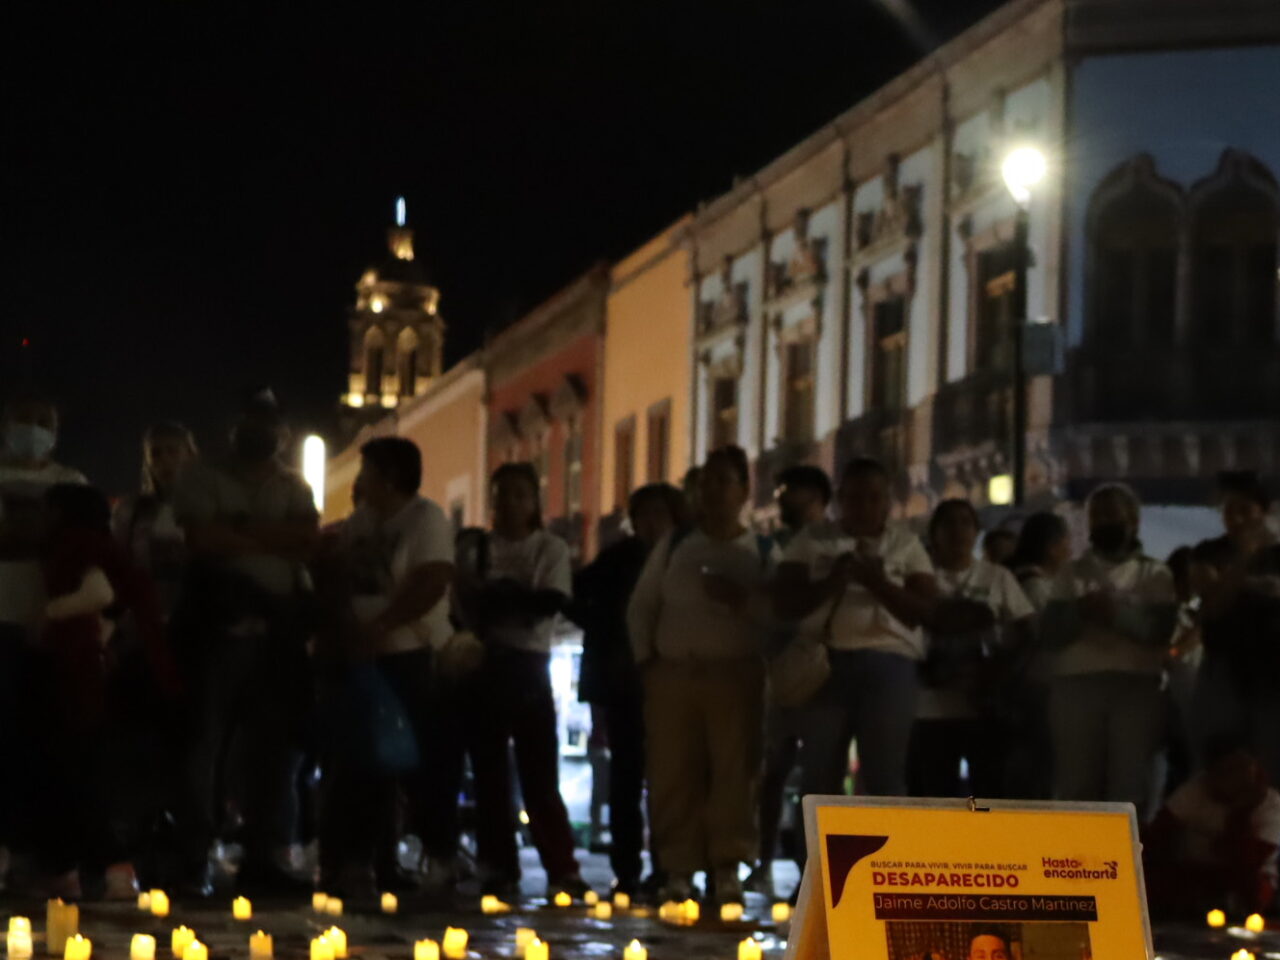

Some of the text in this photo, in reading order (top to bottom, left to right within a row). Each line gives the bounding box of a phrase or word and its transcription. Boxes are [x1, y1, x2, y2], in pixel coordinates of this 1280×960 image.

[904, 861, 927, 869] PARA
[872, 871, 1019, 888] DESAPARECIDO
[1043, 868, 1118, 880] encontrarte
[875, 895, 923, 910] Jaime
[926, 895, 977, 911] Adolfo
[979, 896, 1028, 911] Castro
